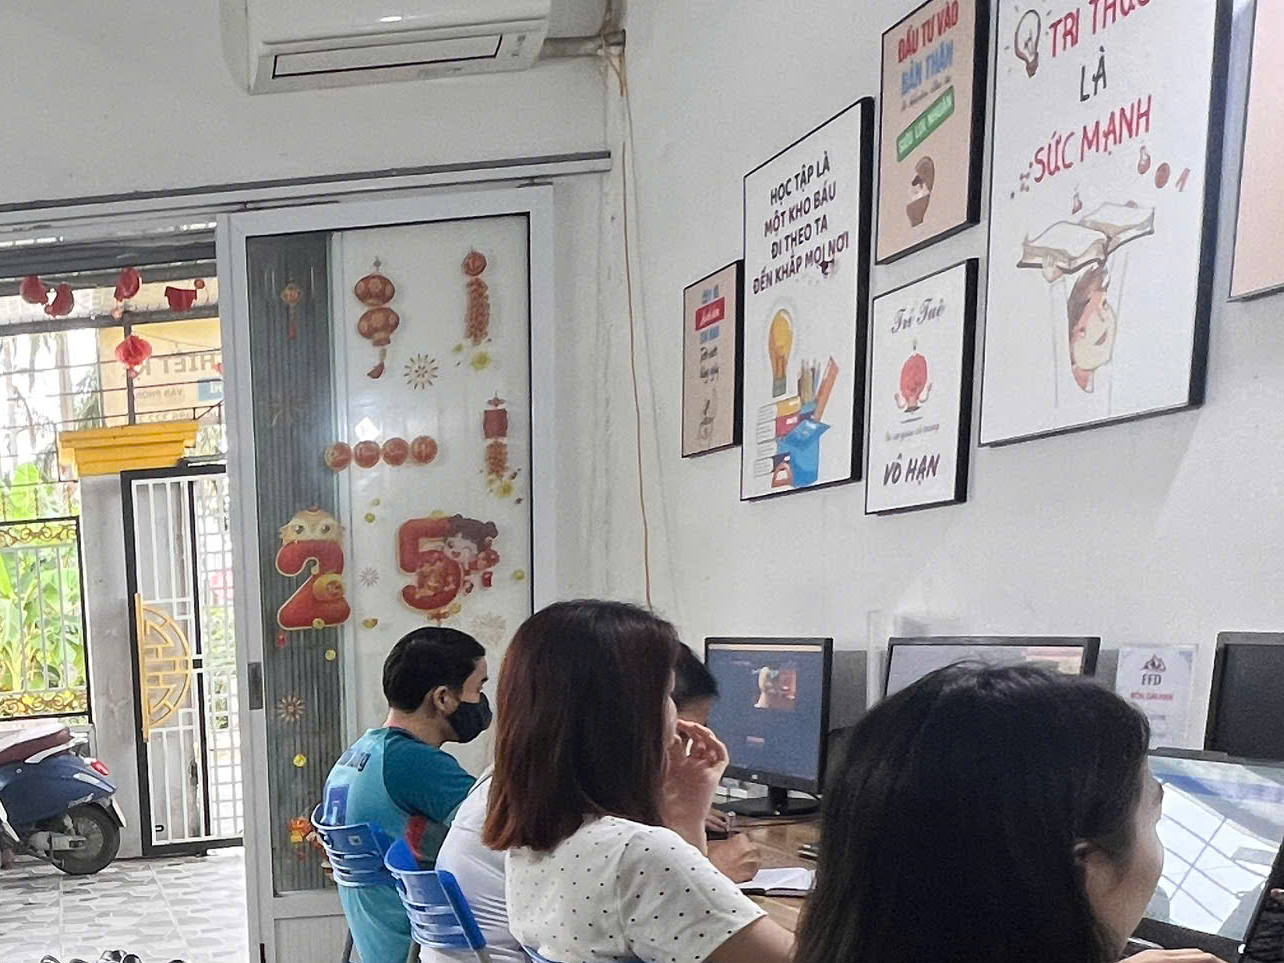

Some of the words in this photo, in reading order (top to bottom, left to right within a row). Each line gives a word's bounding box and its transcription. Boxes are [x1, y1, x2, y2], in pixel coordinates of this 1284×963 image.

[1048, 7, 1080, 57] TRI
[1089, 0, 1150, 35] TH
[1079, 45, 1107, 102] LÀ
[1033, 130, 1076, 182] SỨC
[1080, 94, 1152, 162] MẠNH
[770, 178, 792, 206] HỌC
[794, 164, 814, 192] TẬP
[816, 150, 831, 178] LÀ
[764, 209, 787, 237] MỘT
[788, 196, 811, 224] KHO
[771, 239, 782, 260] ĐI
[784, 223, 812, 252] THEO
[814, 214, 828, 236] TA
[752, 266, 773, 294] ĐẾN
[775, 253, 803, 284] KHẮP
[805, 244, 825, 269] MỌI
[827, 231, 849, 258] NƠI
[883, 453, 903, 486] VÔ
[904, 453, 941, 486] HẠN
